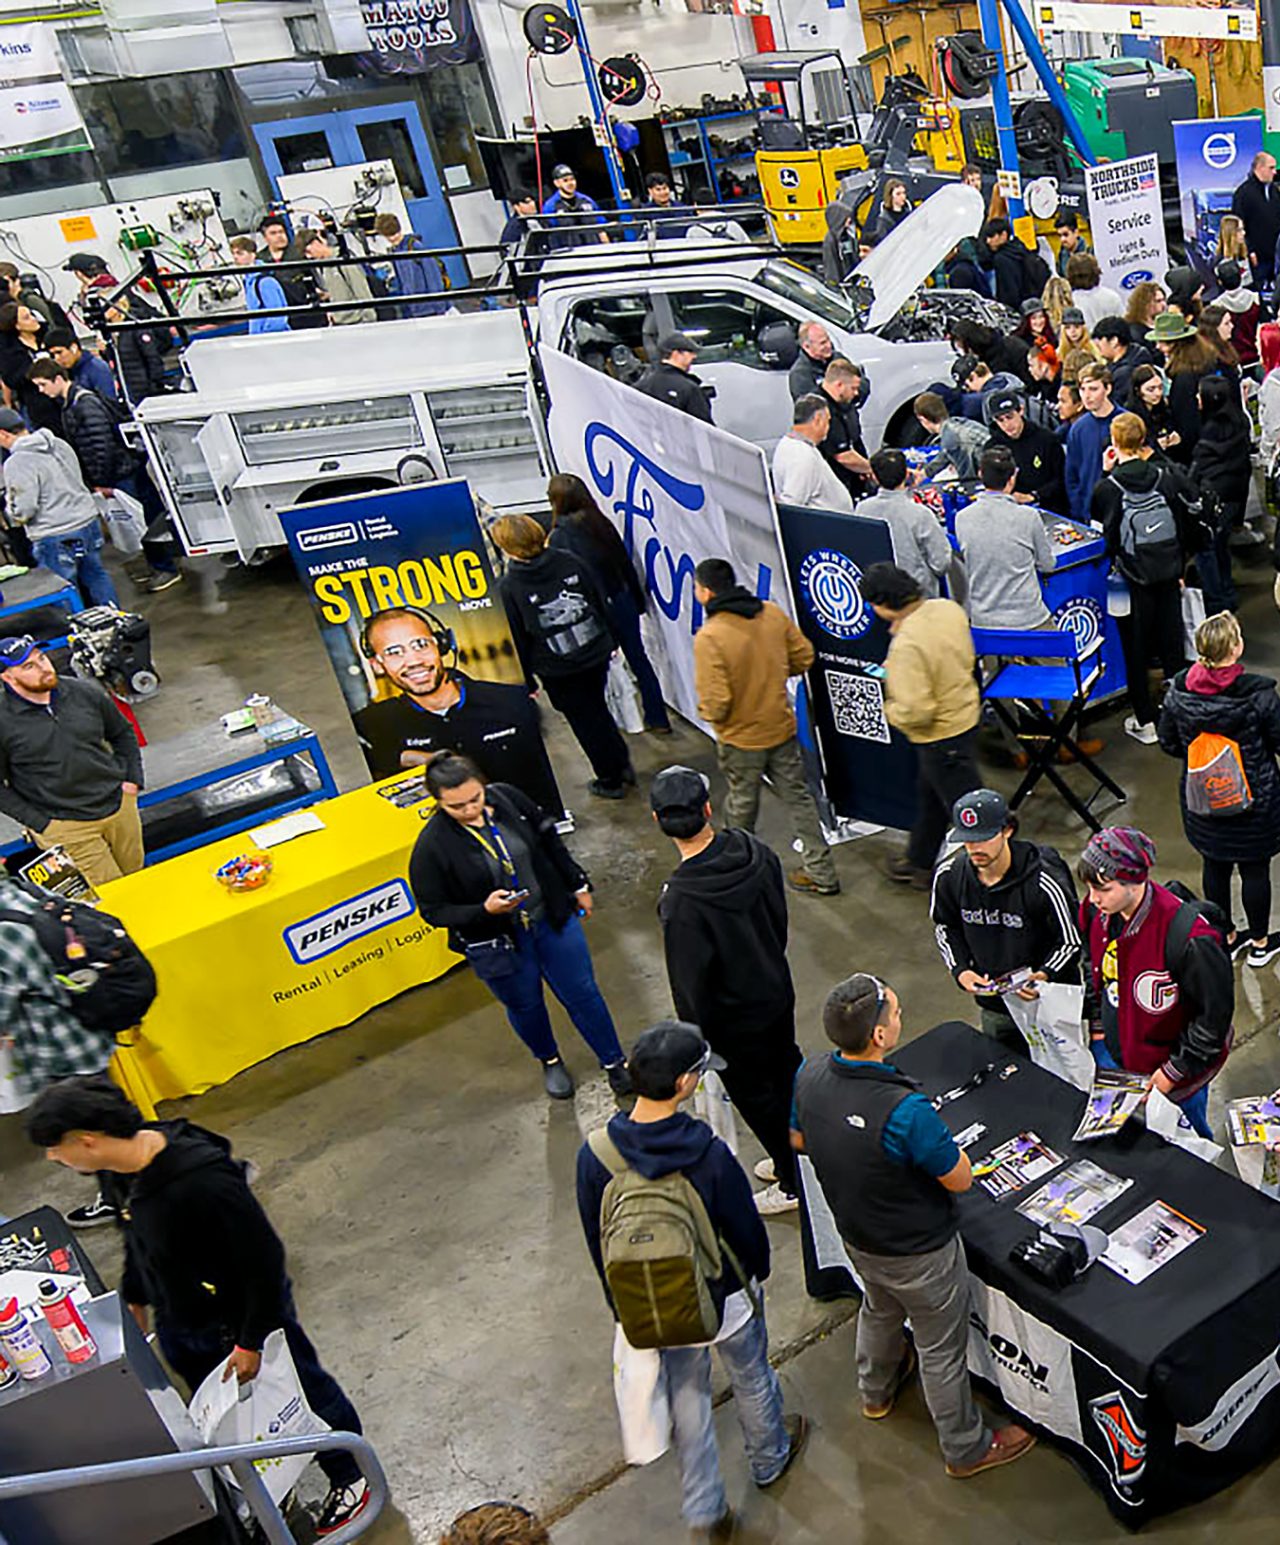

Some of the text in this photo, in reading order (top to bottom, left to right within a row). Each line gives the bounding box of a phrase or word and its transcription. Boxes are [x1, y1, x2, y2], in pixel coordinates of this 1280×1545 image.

[361, 0, 449, 26] MATCO
[368, 19, 457, 52] TOOLS
[0, 43, 32, 56] kins
[1089, 158, 1156, 186] NORTHSIDE
[1091, 177, 1139, 201] TRUCKS
[1108, 212, 1152, 234] Service
[1109, 248, 1161, 268] Medium Duty
[1118, 238, 1146, 255] Light &
[303, 529, 351, 545] PENSKE
[308, 556, 369, 576] MAKE THE
[819, 551, 865, 586] WRENC
[314, 550, 488, 624] STRONG
[459, 598, 492, 611] MOVE
[811, 605, 870, 637] TOGETHER
[300, 892, 401, 950] PENSKE
[273, 976, 322, 1003] Rental
[333, 947, 384, 979] Leasing
